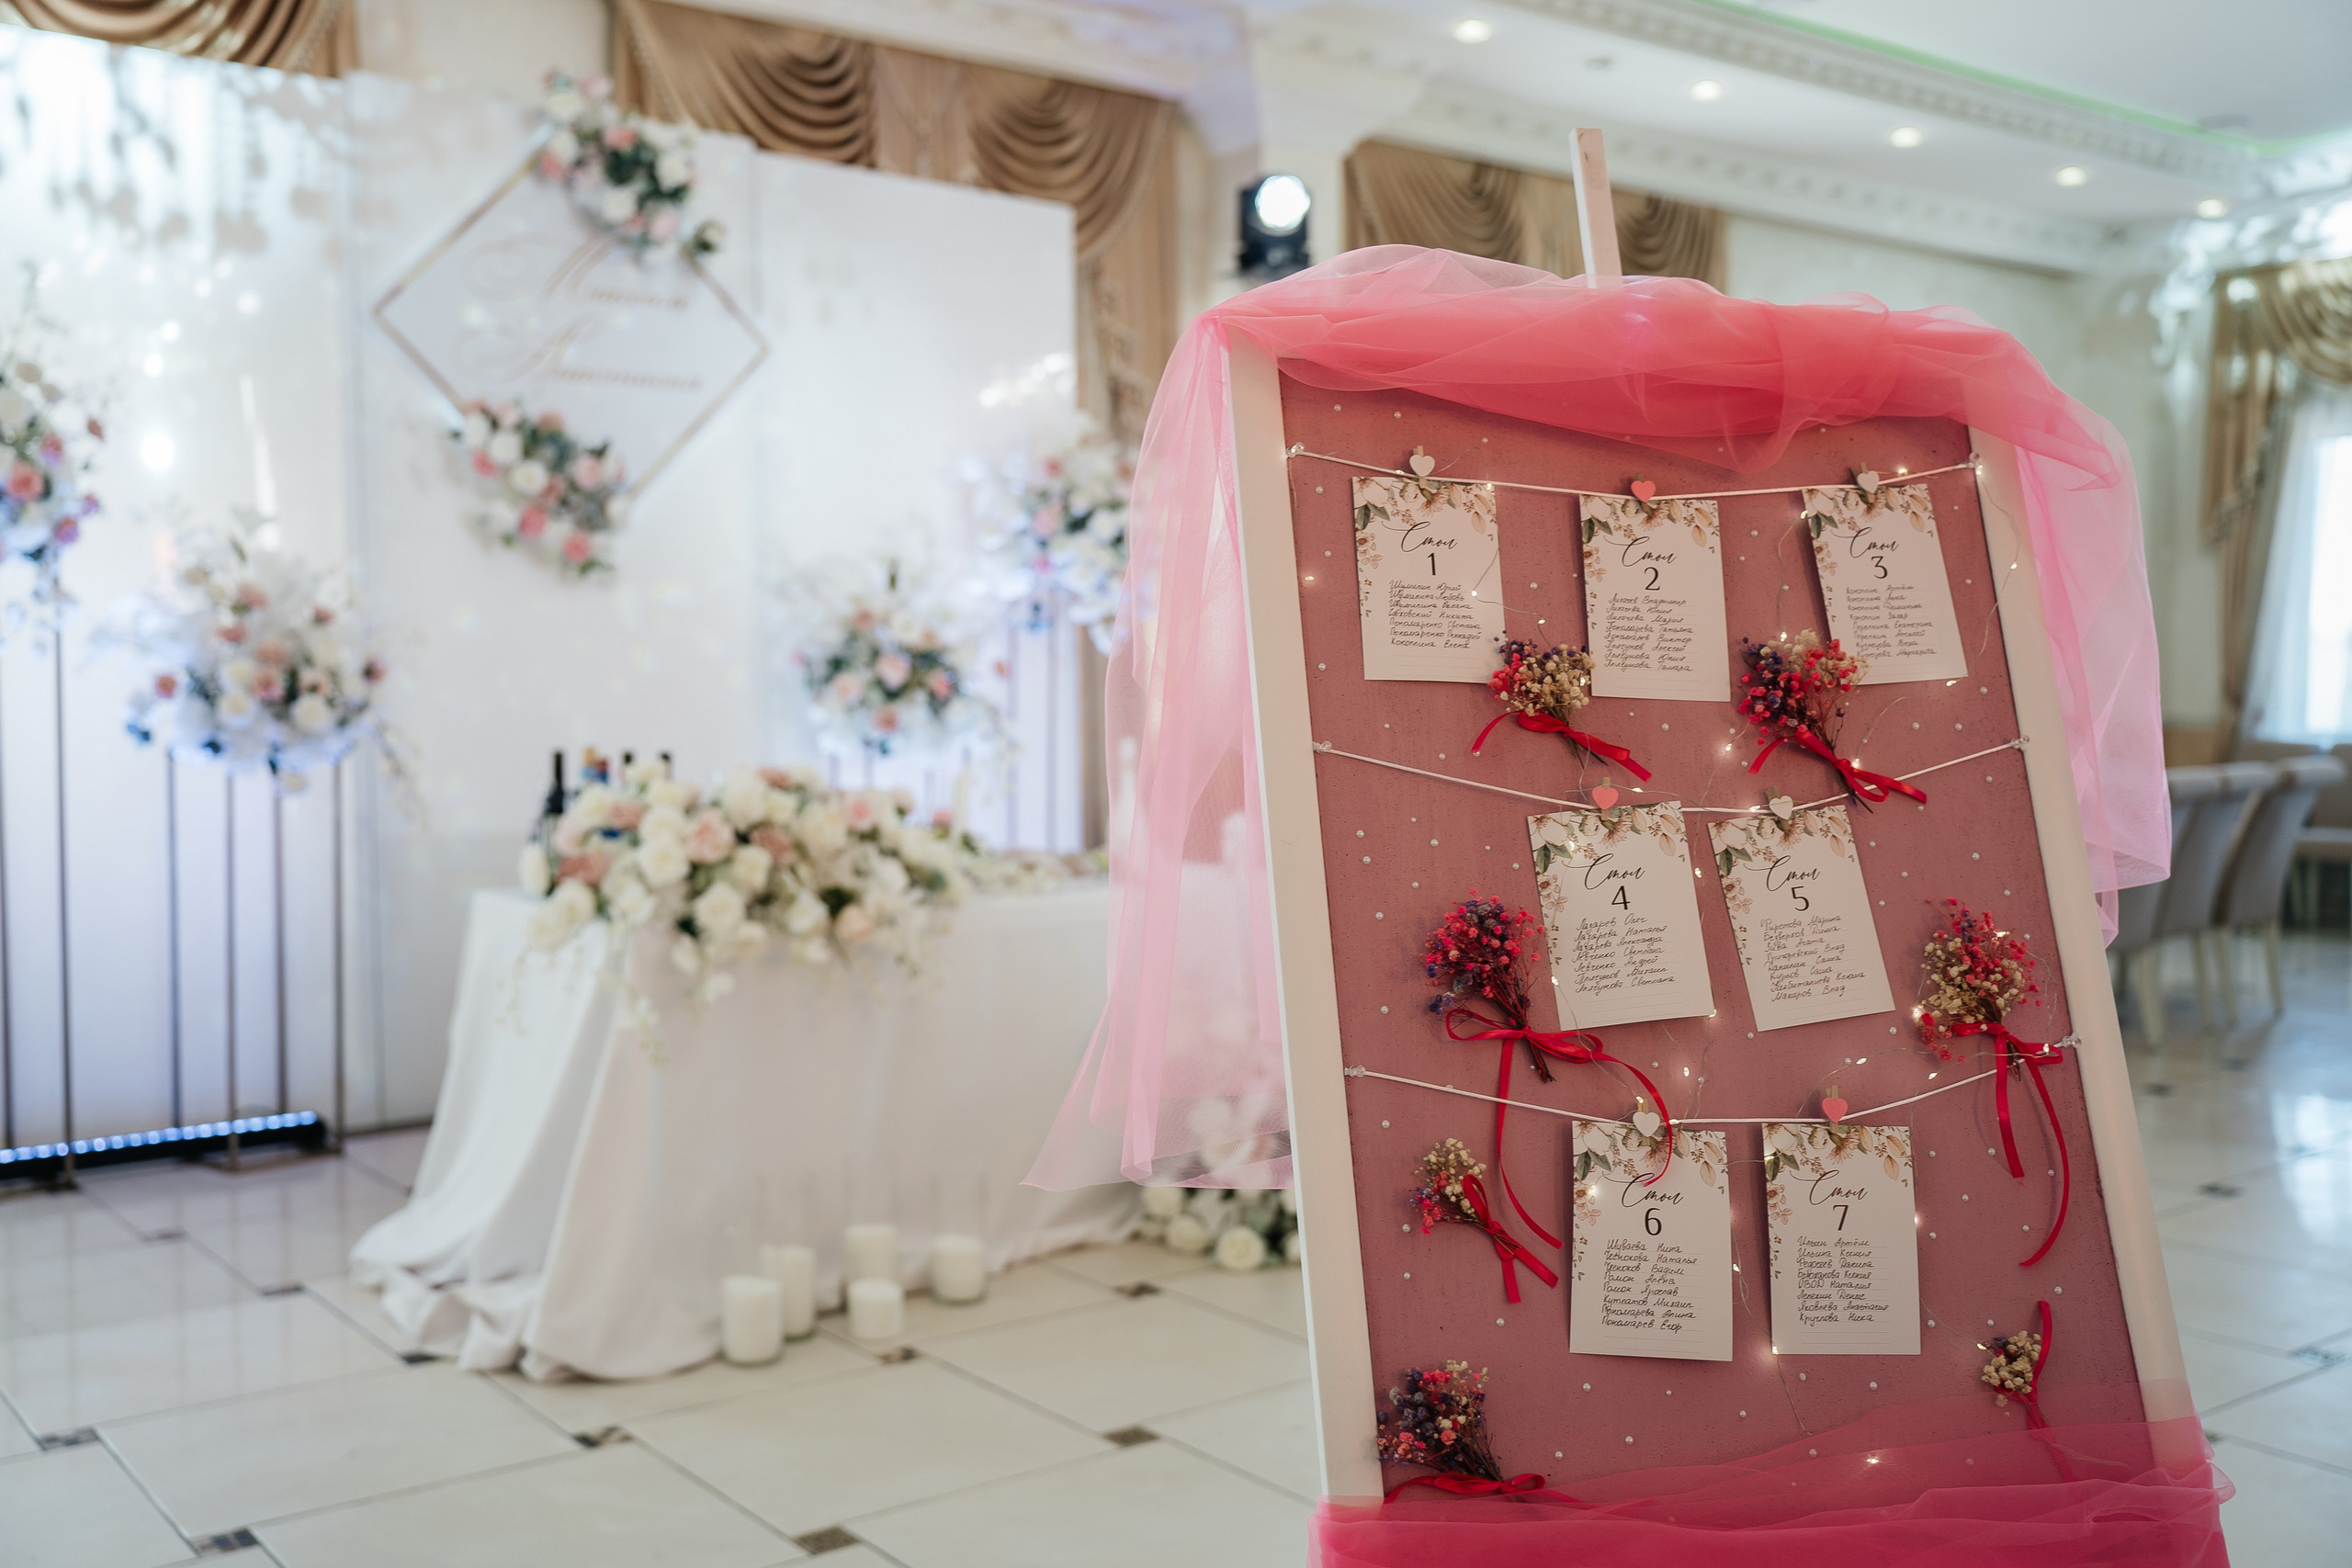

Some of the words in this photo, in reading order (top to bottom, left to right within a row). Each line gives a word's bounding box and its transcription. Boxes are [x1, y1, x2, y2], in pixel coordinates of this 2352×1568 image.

[1382, 521, 1458, 553] Стол
[1830, 526, 1899, 558] Стол
[1604, 536, 1677, 567] Стол
[1427, 552, 1436, 576] 1
[1871, 556, 1888, 580] 3
[1436, 581, 1462, 595] Юрий
[1644, 567, 1660, 591] 2
[1439, 611, 1474, 619] Никита
[1443, 639, 1470, 649] Елена
[1657, 660, 1693, 671] Тамара
[1560, 853, 1645, 890] Стол
[1743, 855, 1820, 892] Стол
[1611, 886, 1631, 910] 4
[1791, 886, 1810, 911] 5
[1577, 917, 1617, 934] Лазарев
[1624, 912, 1647, 925] Олег
[1574, 929, 1618, 944] Лазарева
[1624, 955, 1658, 967] Андрей
[1632, 976, 1676, 987] Светлана
[1601, 1171, 1684, 1208] Стол
[1789, 1169, 1868, 1205] Стол
[1645, 1207, 1662, 1236] 6
[1833, 1204, 1849, 1231] 7
[1607, 1238, 1647, 1255] Шуваева
[1657, 1243, 1682, 1253] Нина
[1651, 1264, 1685, 1278] Вадим
[1653, 1298, 1694, 1308] Михаил
[1662, 1310, 1697, 1319] Алина
[1660, 1319, 1682, 1334] Егор
